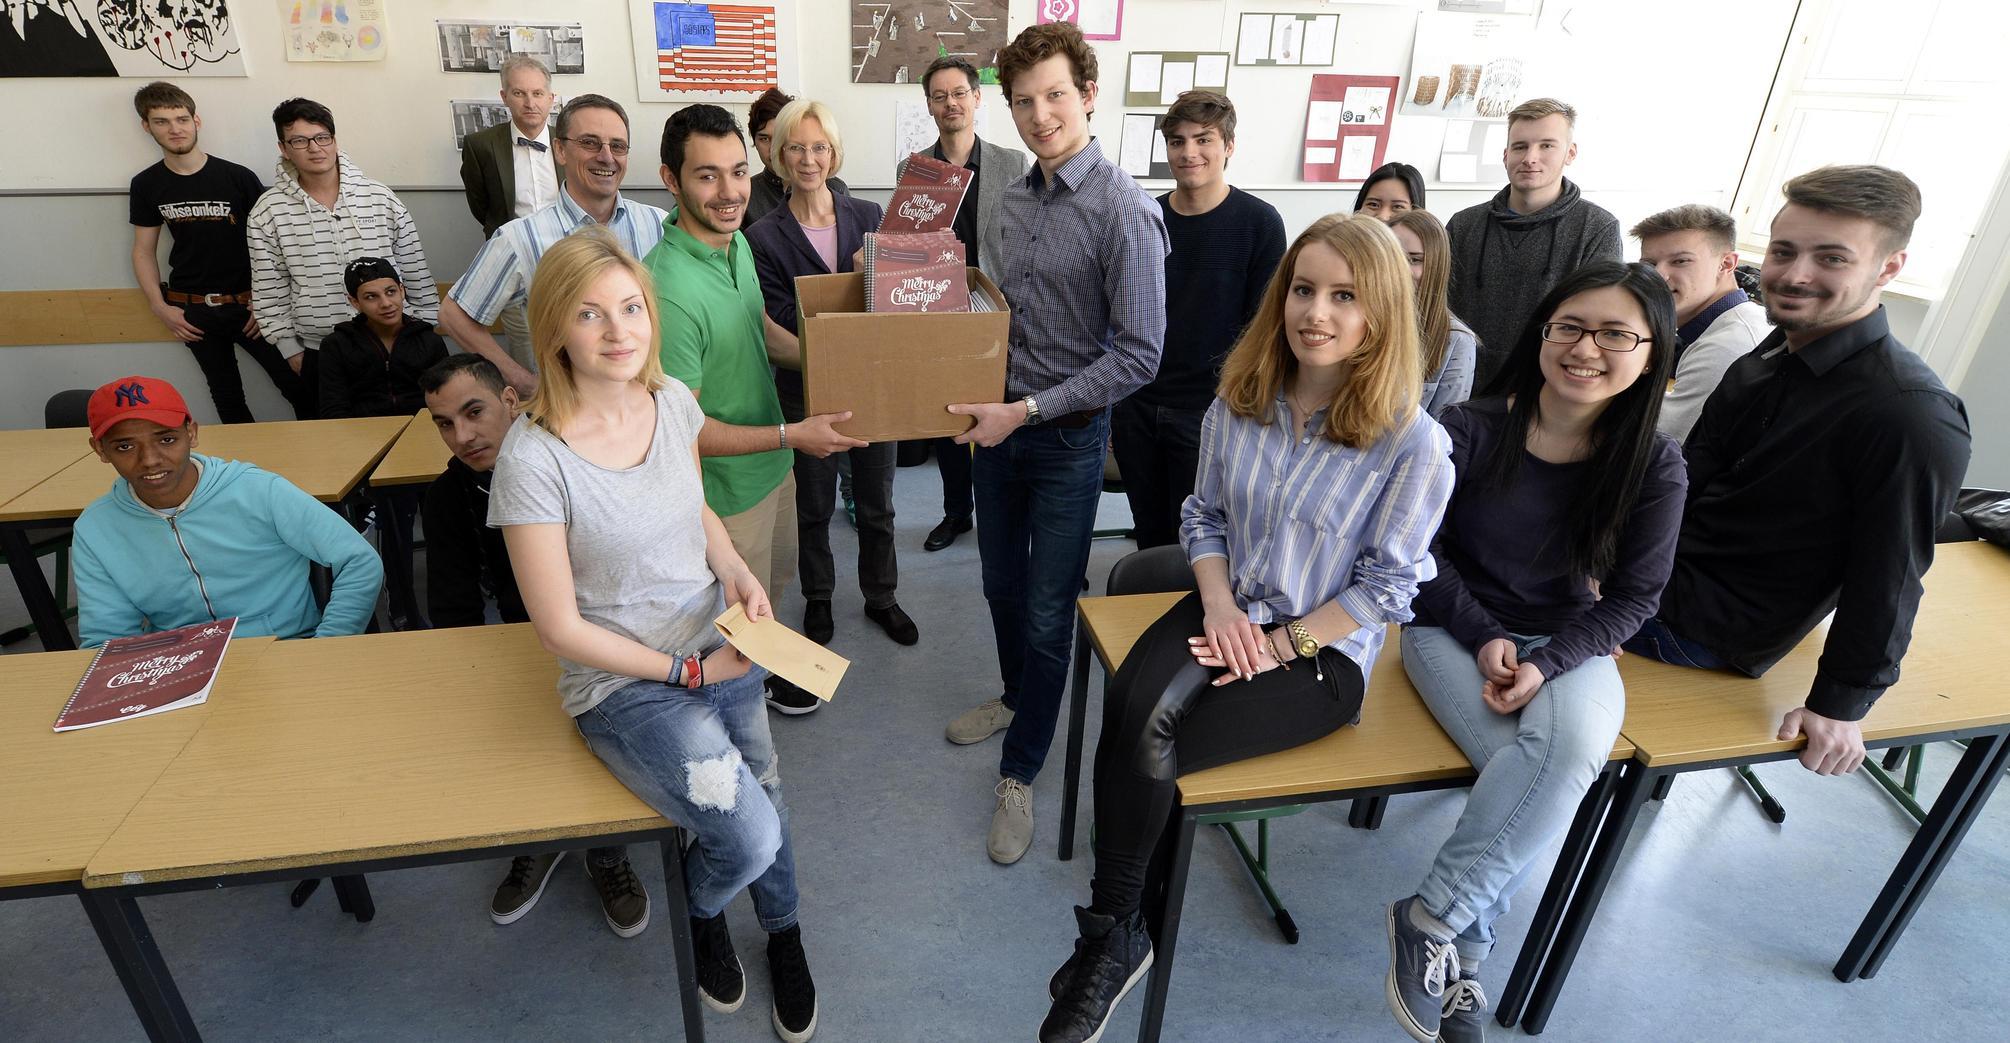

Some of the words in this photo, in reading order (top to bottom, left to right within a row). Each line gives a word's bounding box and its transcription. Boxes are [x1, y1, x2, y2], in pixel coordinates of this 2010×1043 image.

[898, 200, 935, 229] Christmas
[911, 193, 936, 212] Merry
[902, 277, 935, 293] Merry
[890, 287, 941, 312] Christmas
[115, 382, 150, 407] NY
[132, 653, 182, 672] Merry
[107, 663, 184, 688] Christmas
